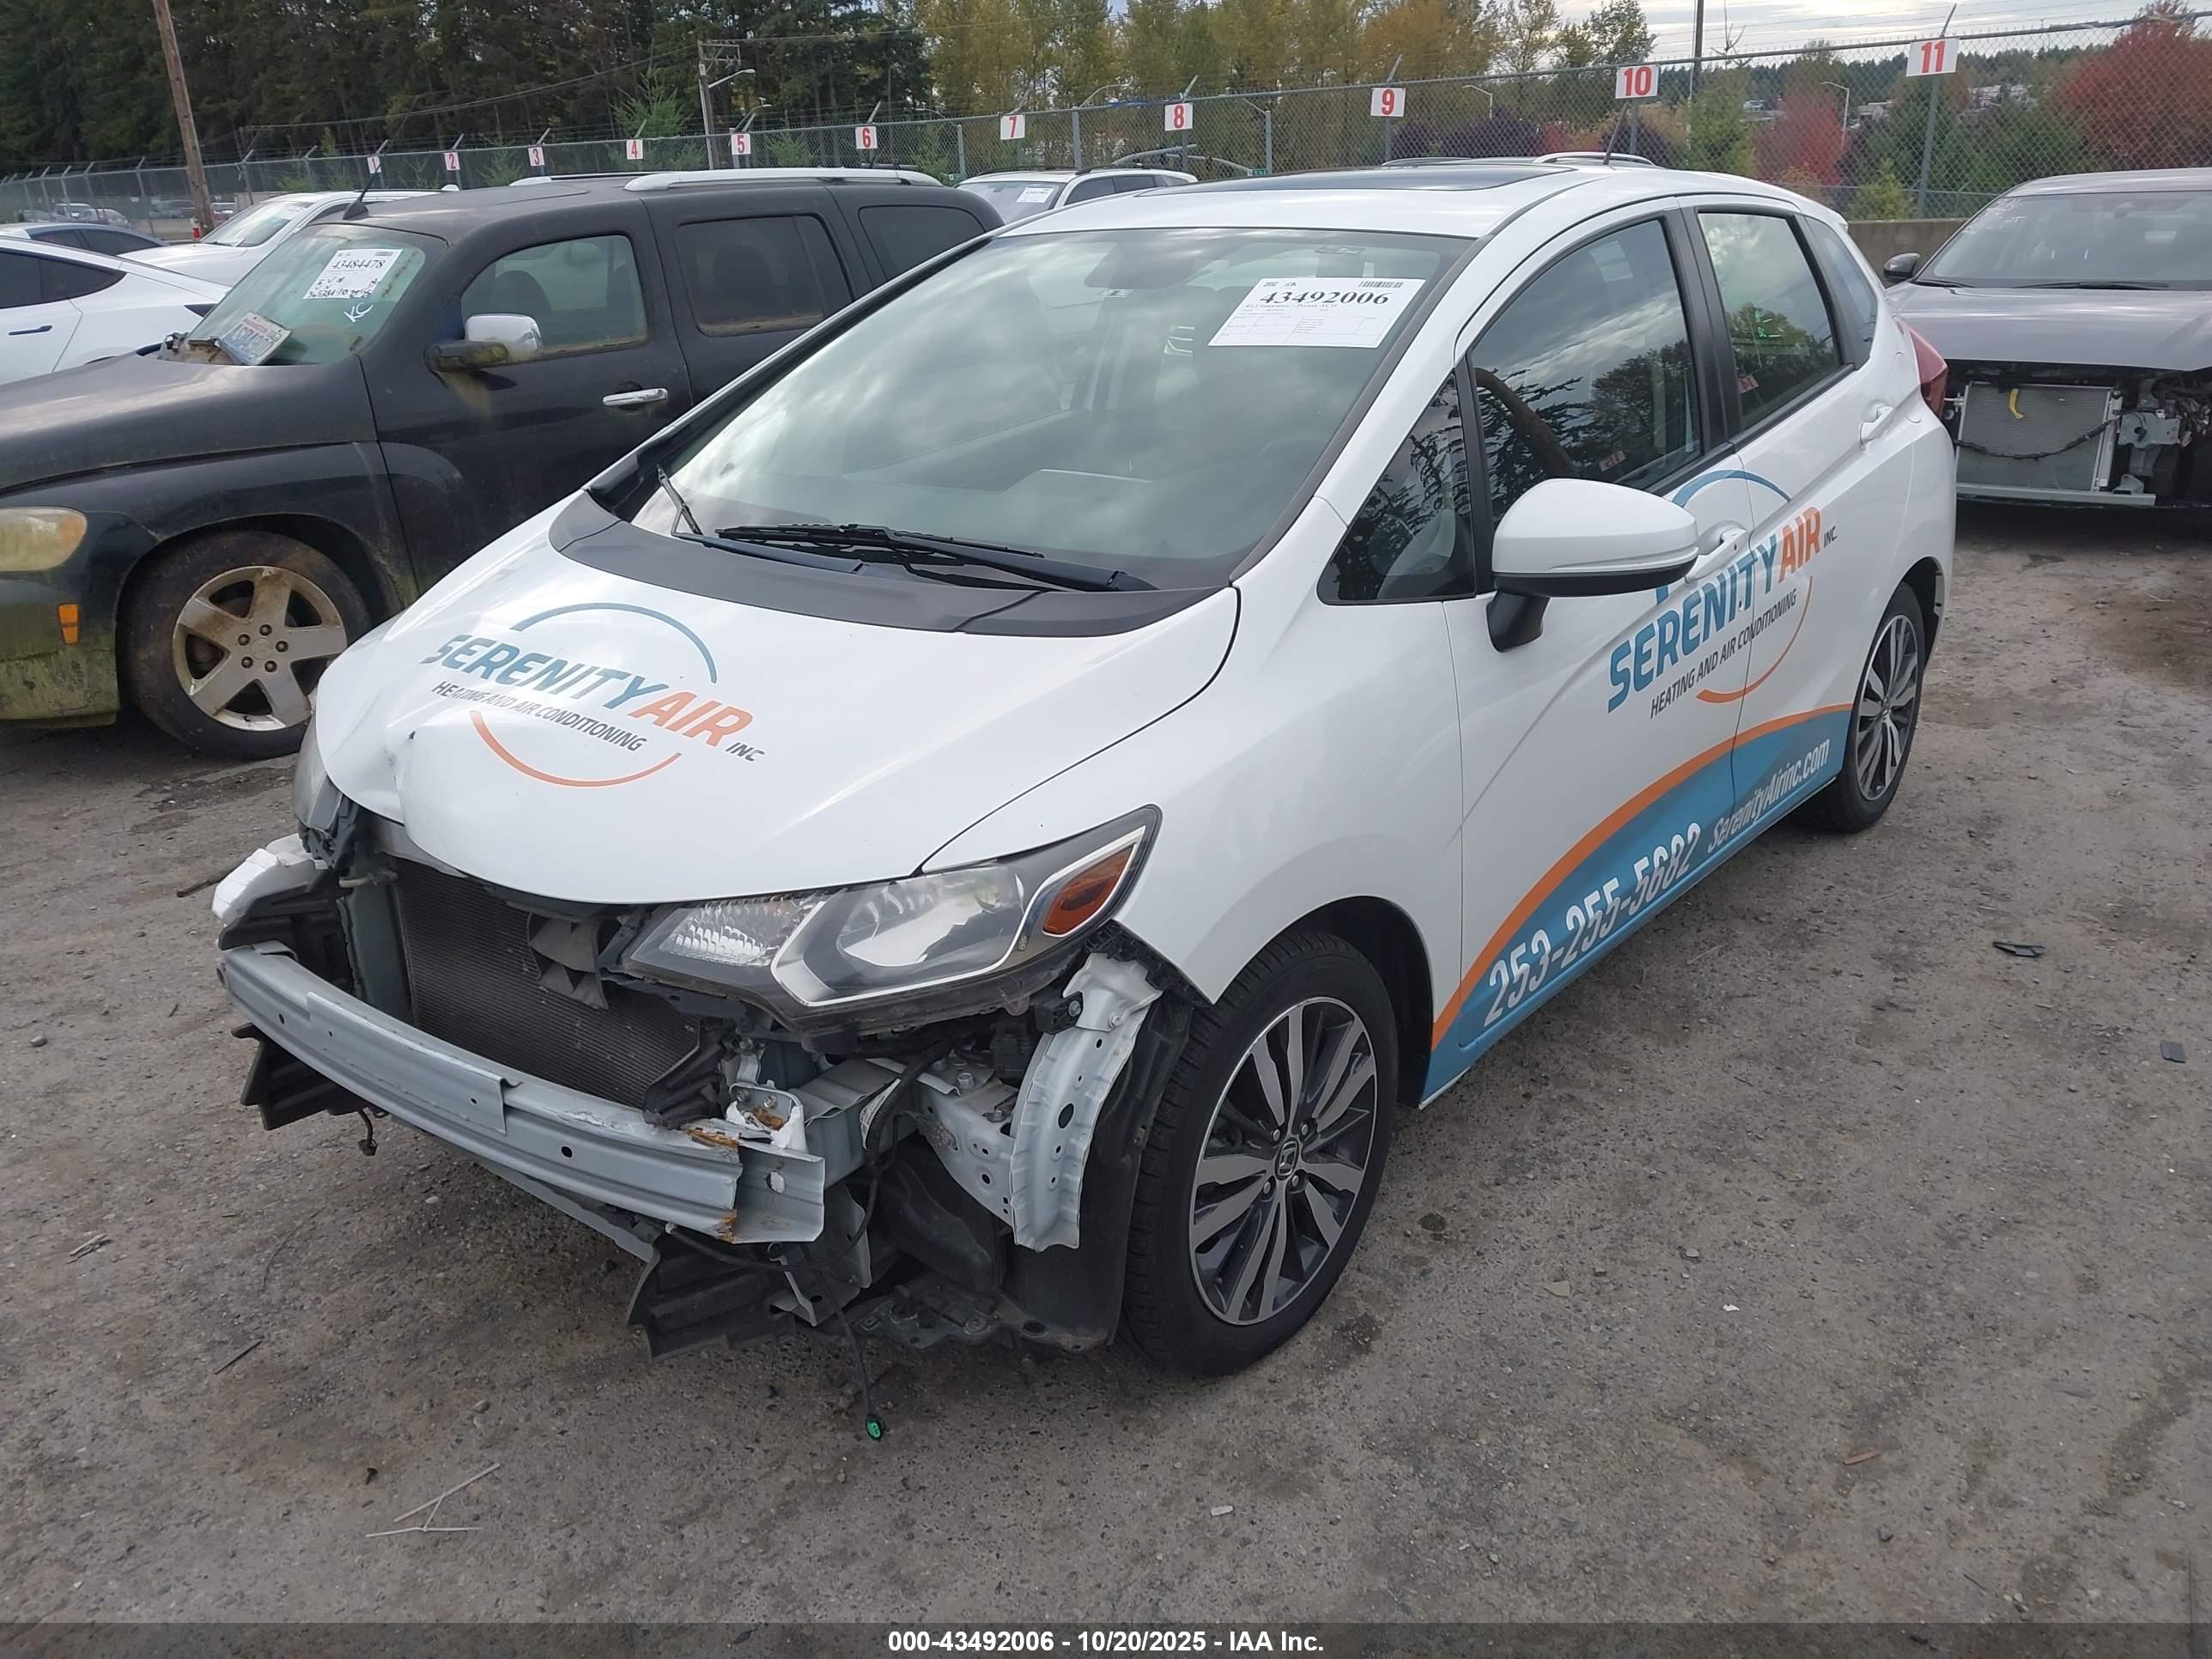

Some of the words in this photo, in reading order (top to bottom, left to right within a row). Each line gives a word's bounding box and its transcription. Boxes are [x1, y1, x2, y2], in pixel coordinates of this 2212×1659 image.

[1923, 41, 1945, 74] 11
[1624, 66, 1652, 96] 10
[1382, 89, 1395, 116] 9
[1009, 116, 1018, 137] 7
[1174, 105, 1184, 129] 8
[736, 134, 745, 152] 5
[861, 127, 872, 148] 6
[533, 148, 541, 166] 3
[630, 142, 638, 158] 4
[448, 153, 456, 169] 2
[332, 259, 386, 270] 43484478
[1260, 290, 1395, 305] 43492006
[343, 301, 374, 322] KC
[1650, 667, 1696, 720] HEATING
[1696, 650, 1718, 683] AND
[1719, 637, 1736, 665] AIR
[1737, 587, 1797, 650] CONDITIONING
[431, 680, 488, 702] HEATING
[480, 693, 517, 709] AND
[508, 700, 542, 715] AIR
[535, 707, 648, 752] CONDITIONING
[1484, 823, 1700, 1027] 253-255-5682
[1708, 738, 1831, 854] SerenityAirinc.com
